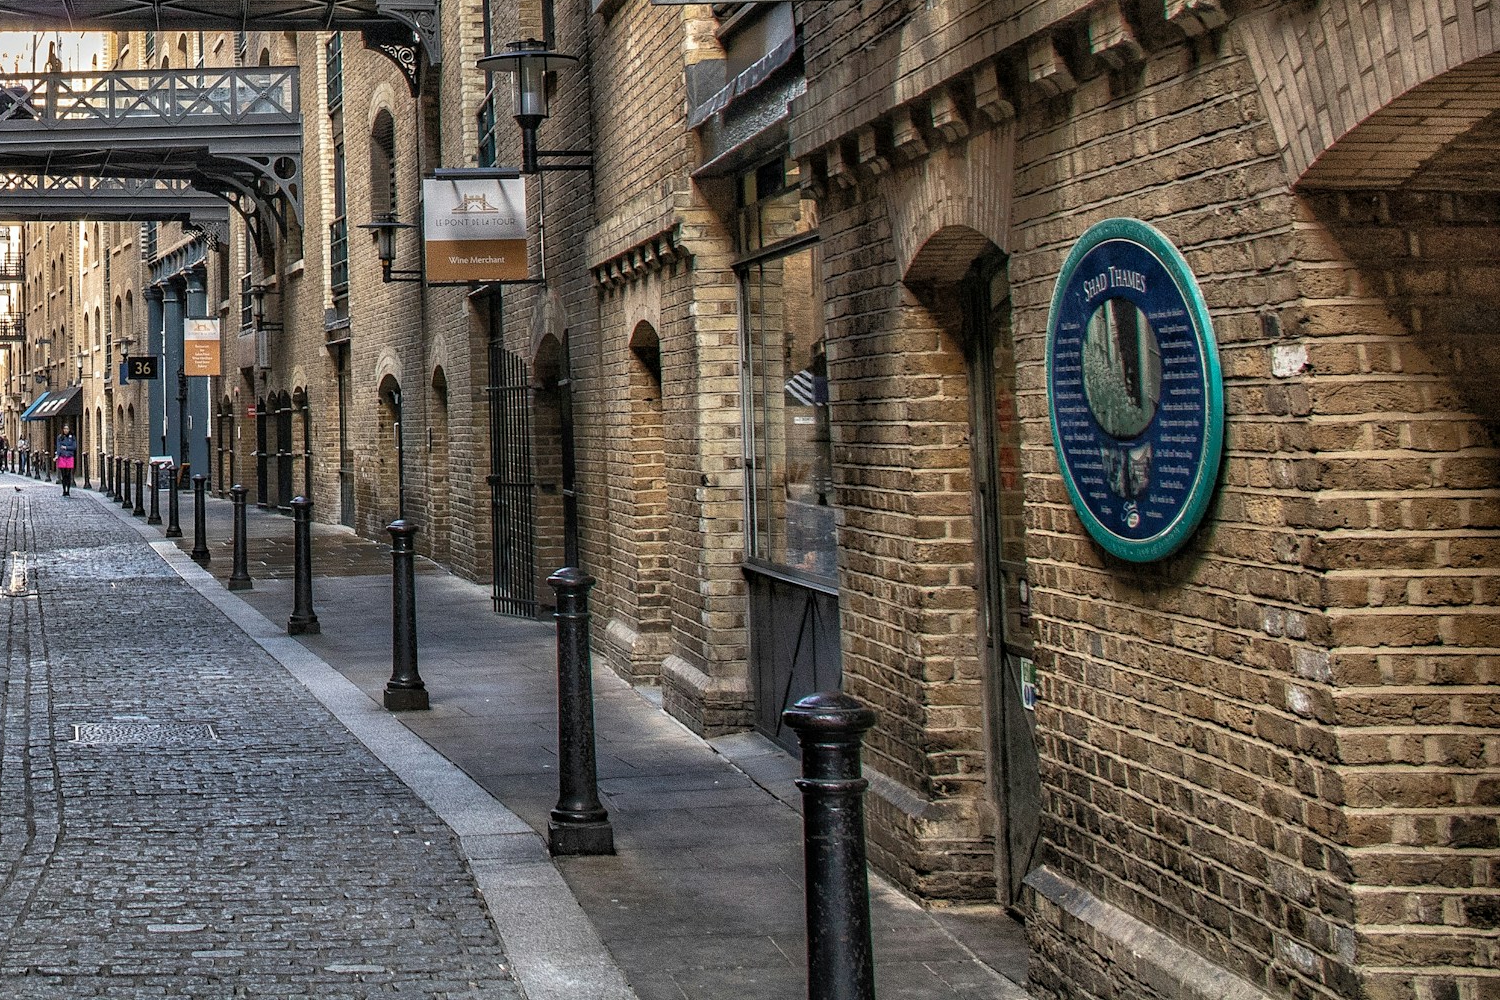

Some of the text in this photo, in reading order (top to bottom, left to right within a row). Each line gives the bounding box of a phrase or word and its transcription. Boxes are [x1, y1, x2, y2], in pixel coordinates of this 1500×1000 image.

[435, 219, 443, 227] LE
[445, 219, 469, 227] PONT
[492, 218, 516, 226] TOUR
[448, 255, 505, 264] Wine Merchant
[1083, 265, 1146, 302] SHAD THAMES
[135, 362, 151, 375] 36
